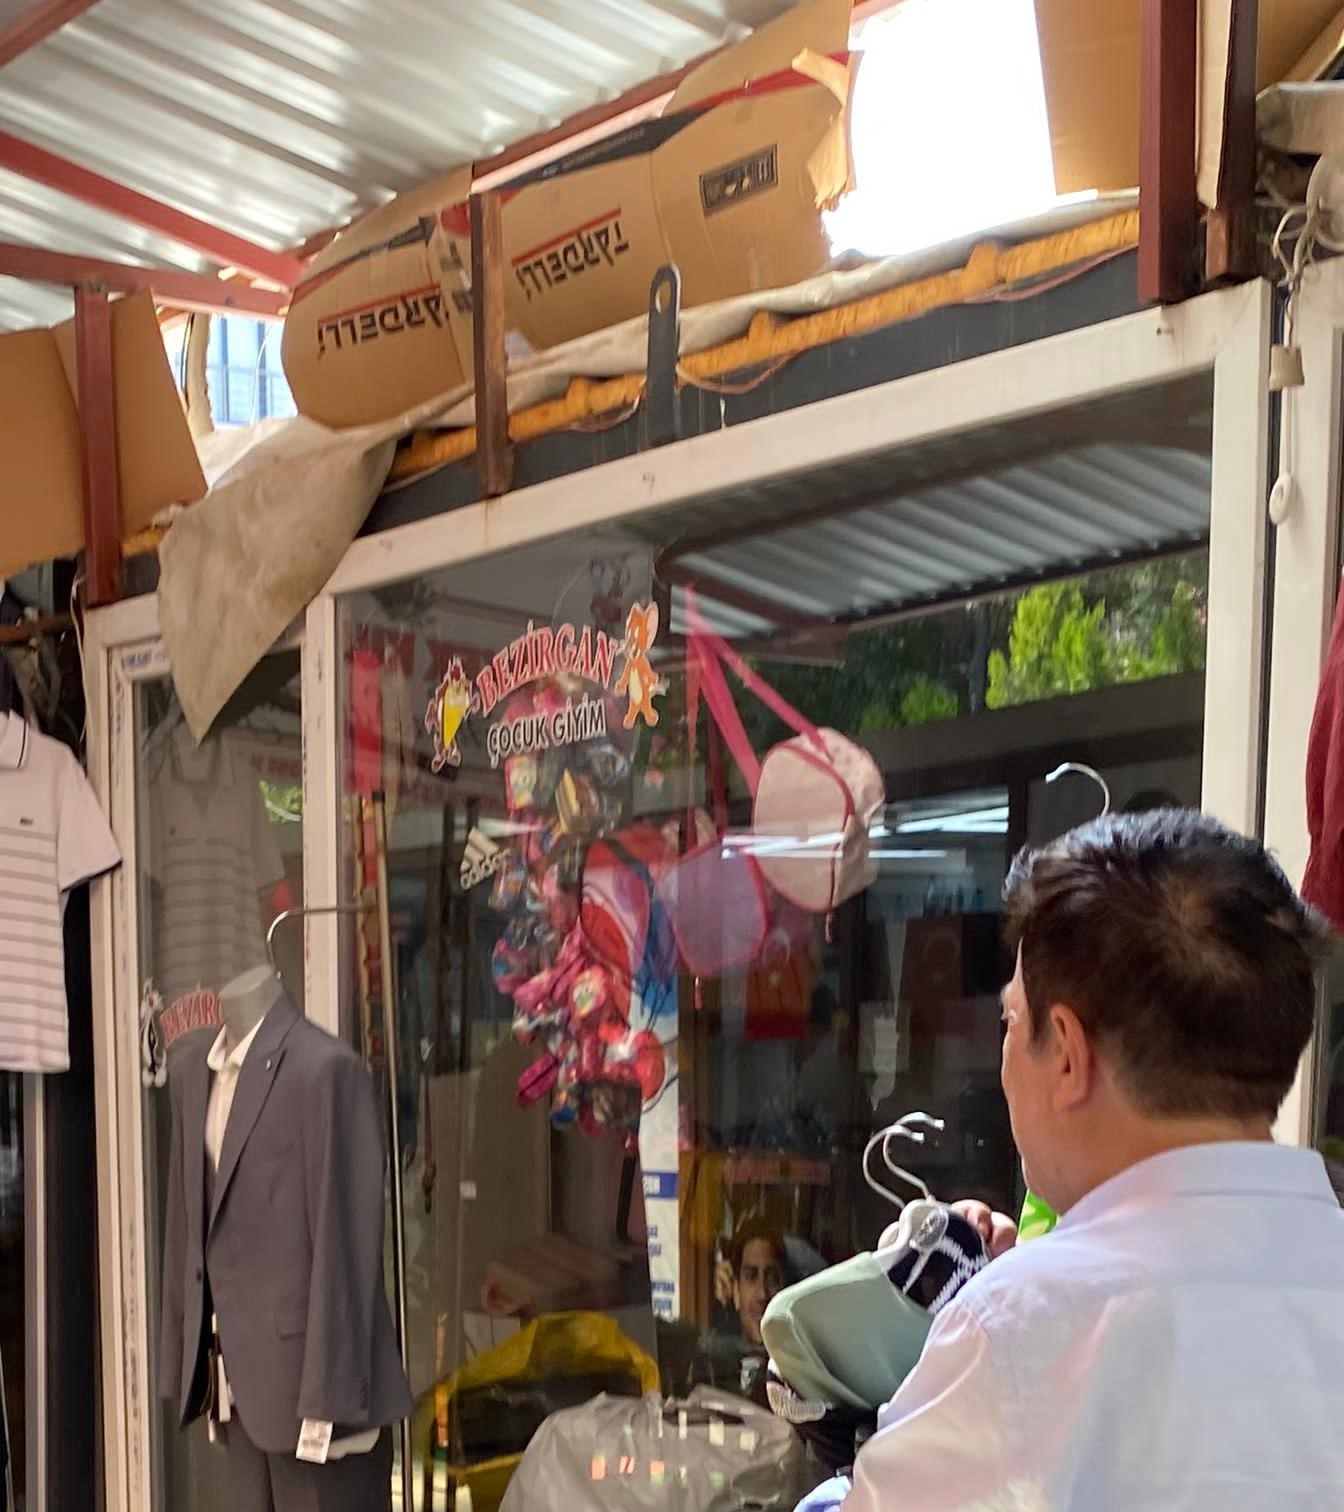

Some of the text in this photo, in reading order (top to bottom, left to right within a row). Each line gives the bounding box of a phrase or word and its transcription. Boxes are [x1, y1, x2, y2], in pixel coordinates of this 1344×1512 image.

[476, 619, 617, 717] BEZİRGAN
[487, 692, 606, 769] ÇOCUK GİYİM
